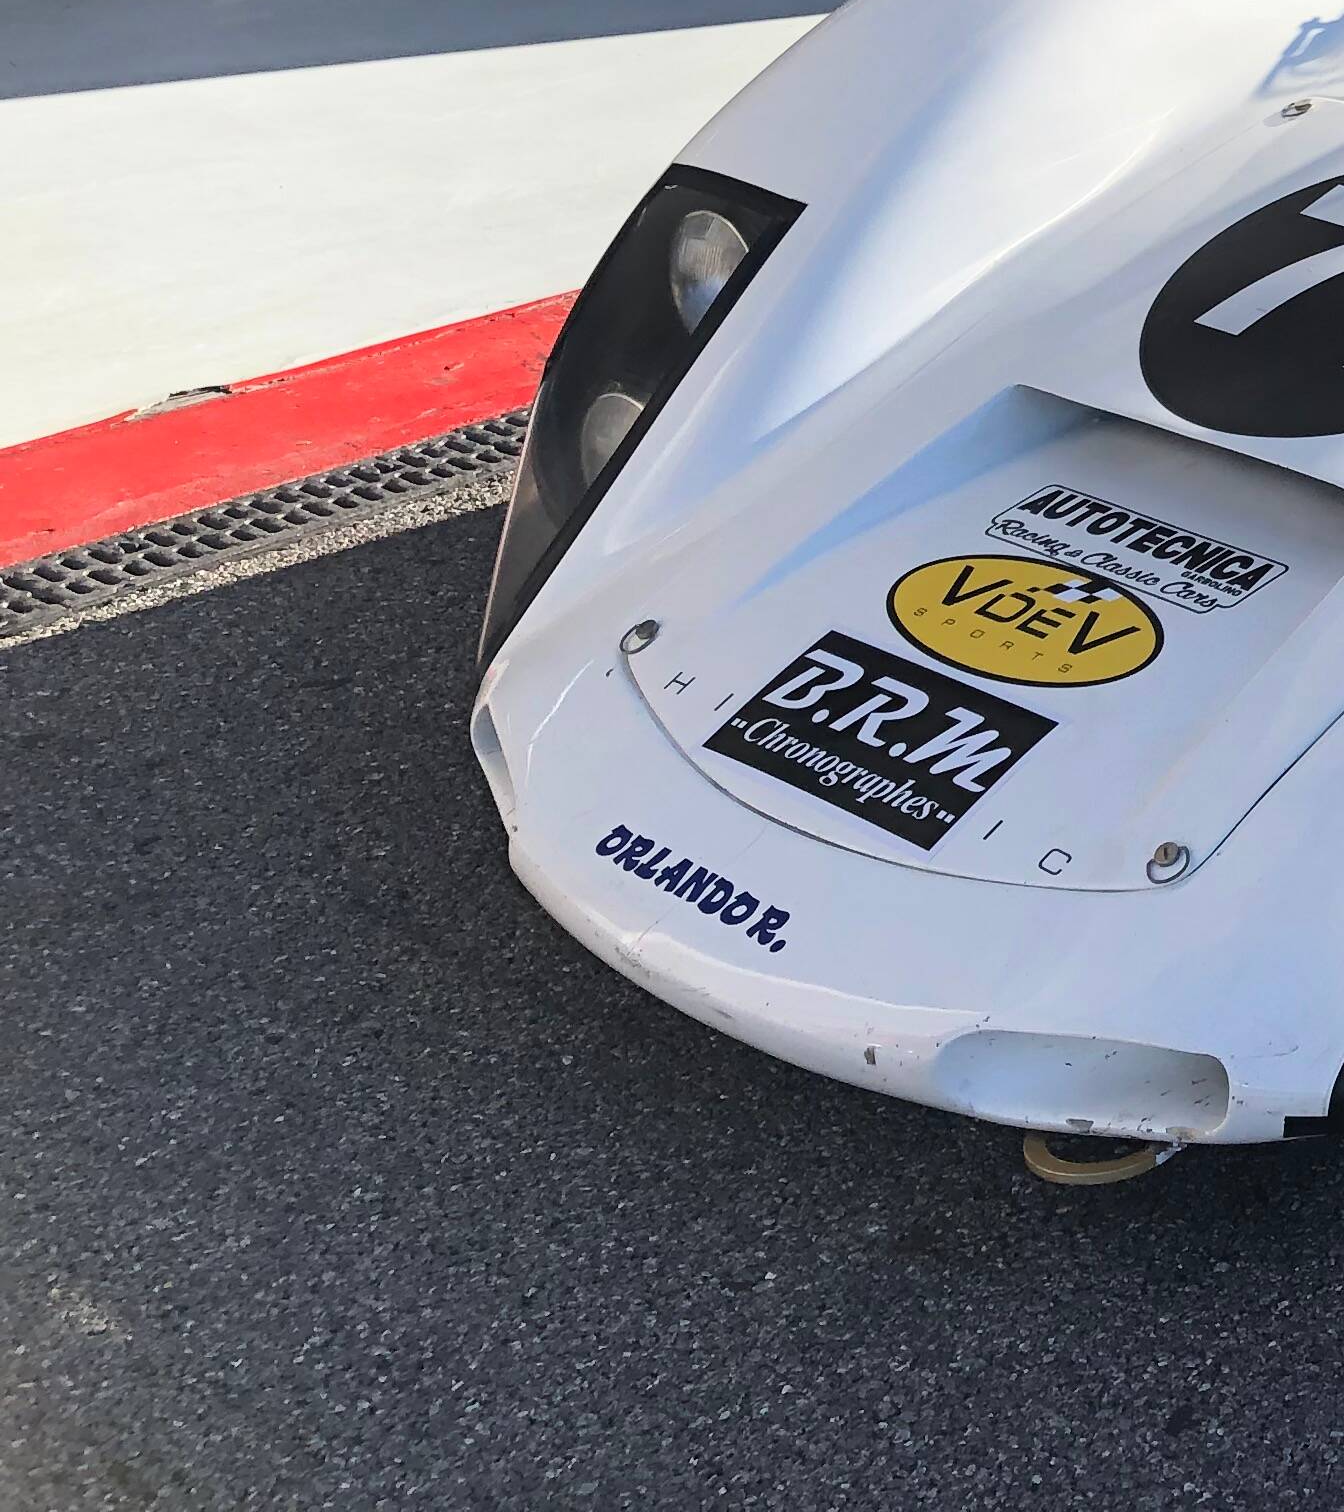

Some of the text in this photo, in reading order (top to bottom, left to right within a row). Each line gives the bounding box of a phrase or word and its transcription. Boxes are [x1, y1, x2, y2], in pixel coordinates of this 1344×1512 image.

[995, 519, 1071, 557] Racing
[1081, 551, 1158, 586] Classic
[1160, 581, 1218, 608] Cars
[1018, 489, 1274, 591] AUTOTECNICA
[913, 607, 1072, 674] SPORTS
[942, 564, 1141, 655] VDEV
[595, 824, 791, 953] ORLANDO R.
